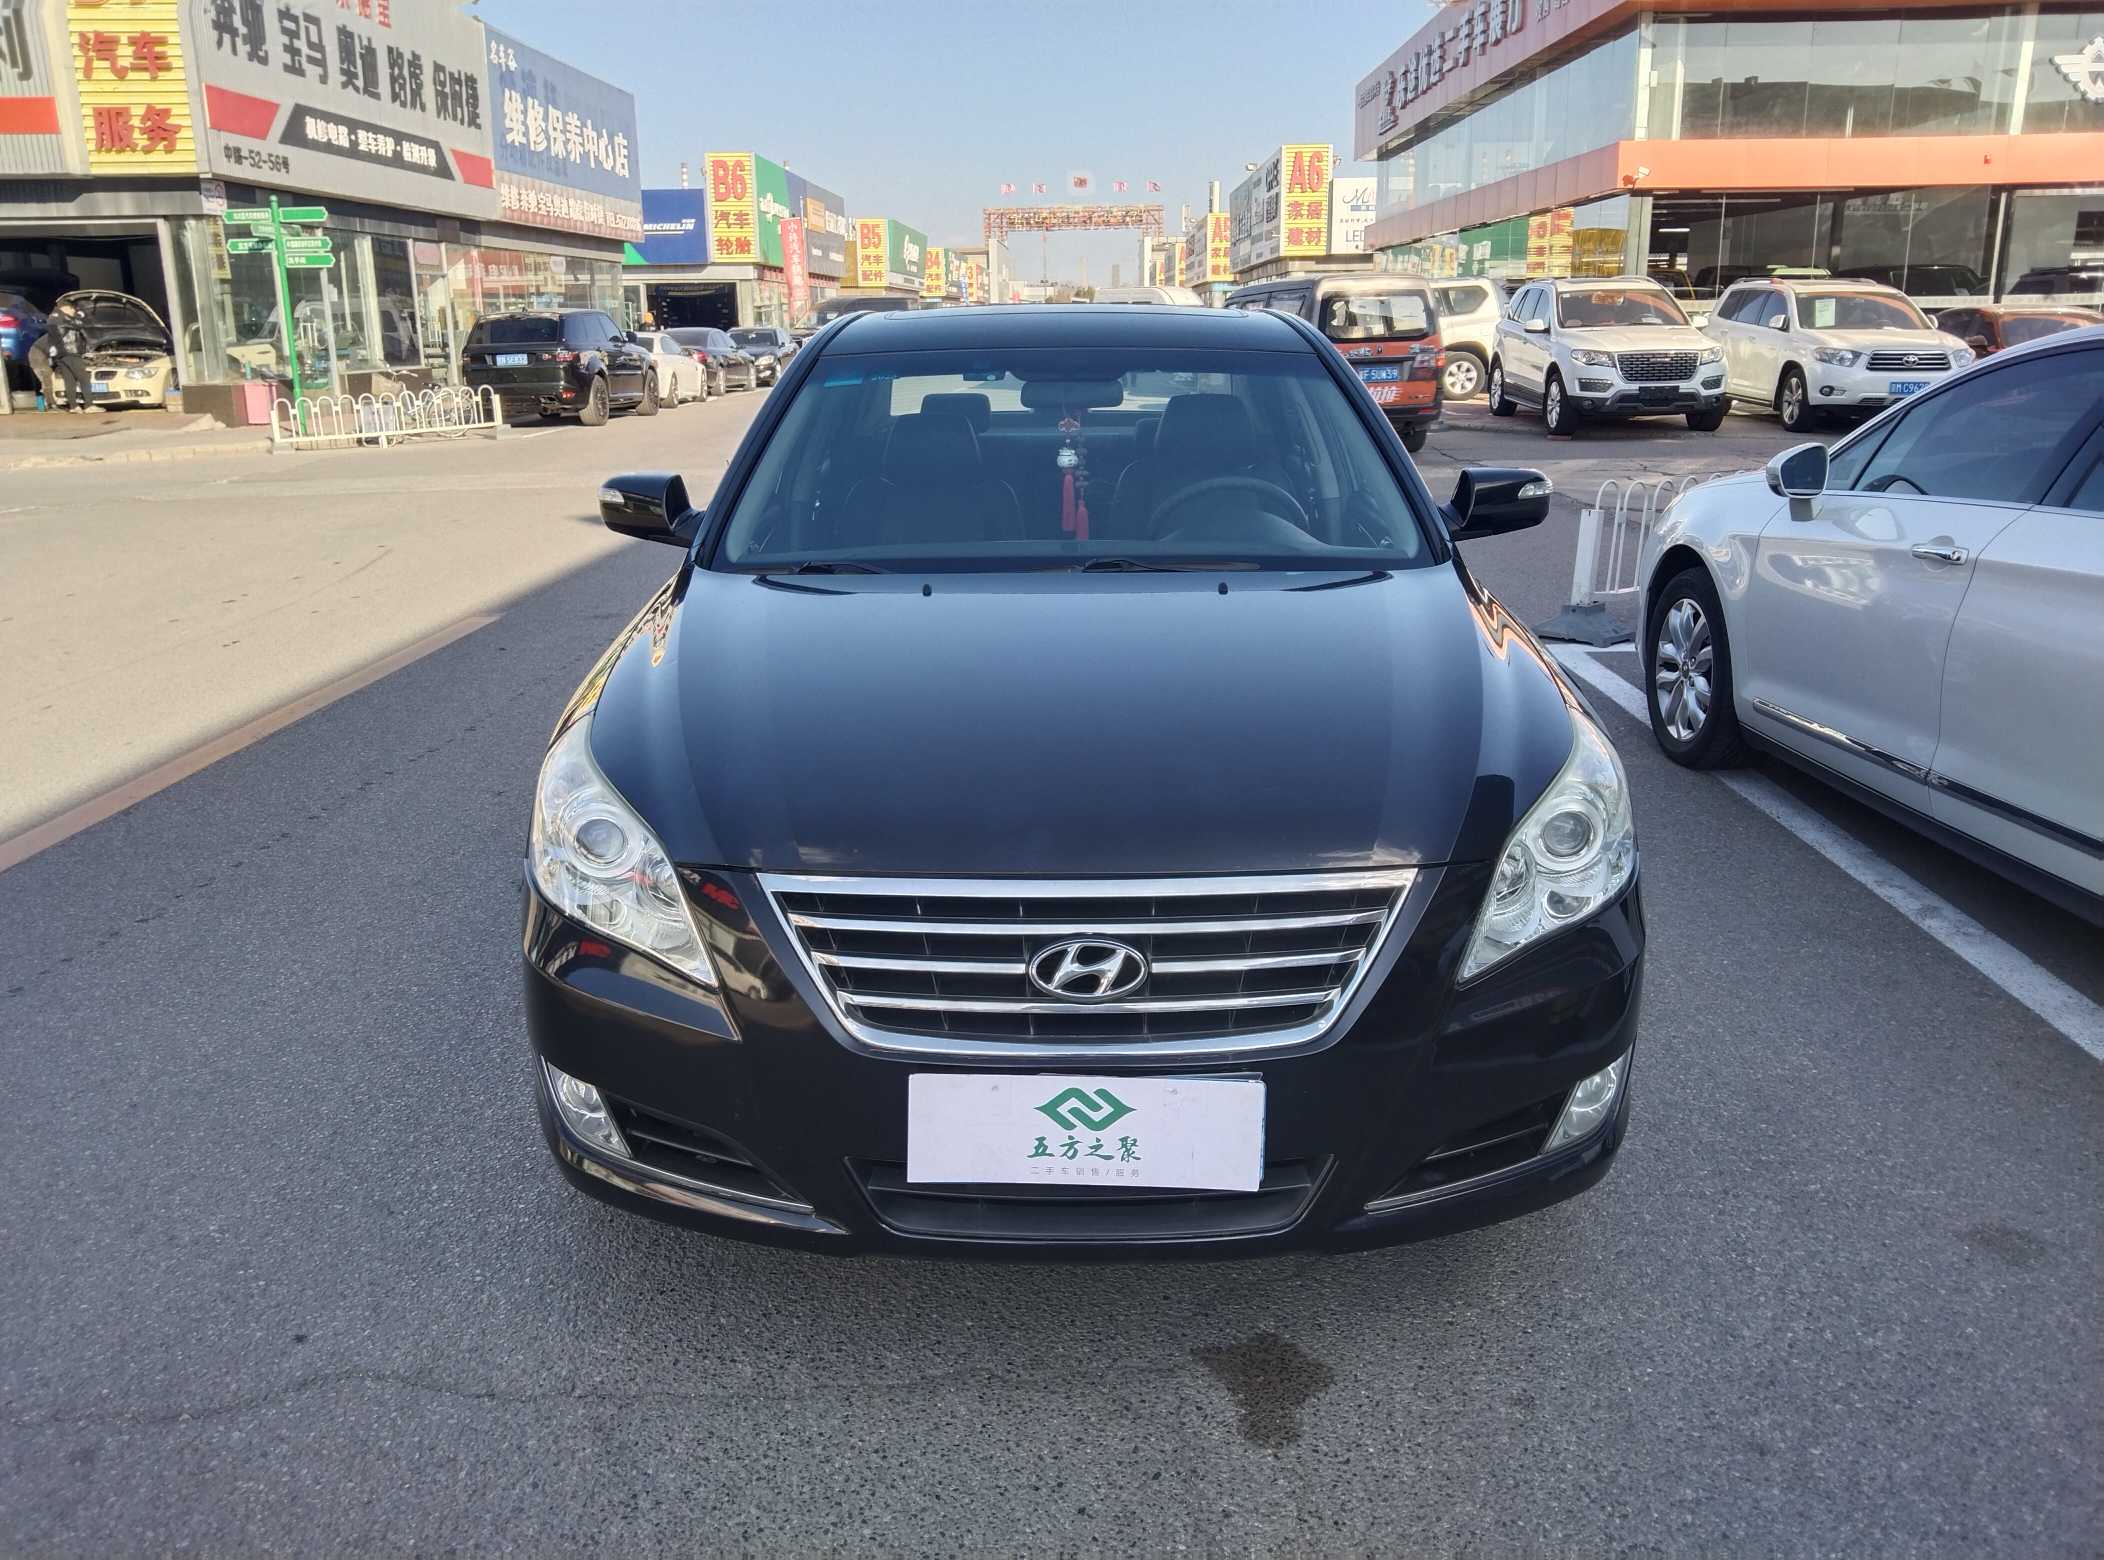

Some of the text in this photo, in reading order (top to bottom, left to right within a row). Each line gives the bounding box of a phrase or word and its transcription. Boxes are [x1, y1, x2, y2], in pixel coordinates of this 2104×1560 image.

[78, 30, 173, 81] 汽车
[277, 5, 328, 85] 宝马
[336, 24, 381, 101] 奥迪
[387, 45, 426, 112] 路虎
[433, 60, 482, 133] 保时捷
[92, 105, 182, 155] 服务
[503, 88, 629, 178] 维修保养中心店
[712, 159, 747, 202] B6
[1289, 151, 1324, 193] A6
[714, 210, 750, 229] 汽车
[860, 223, 882, 249] B5
[716, 236, 751, 255] 轮胎
[861, 253, 883, 266] 汽车
[926, 251, 941, 269] B4
[1026, 1134, 1142, 1163] 五方之聚
